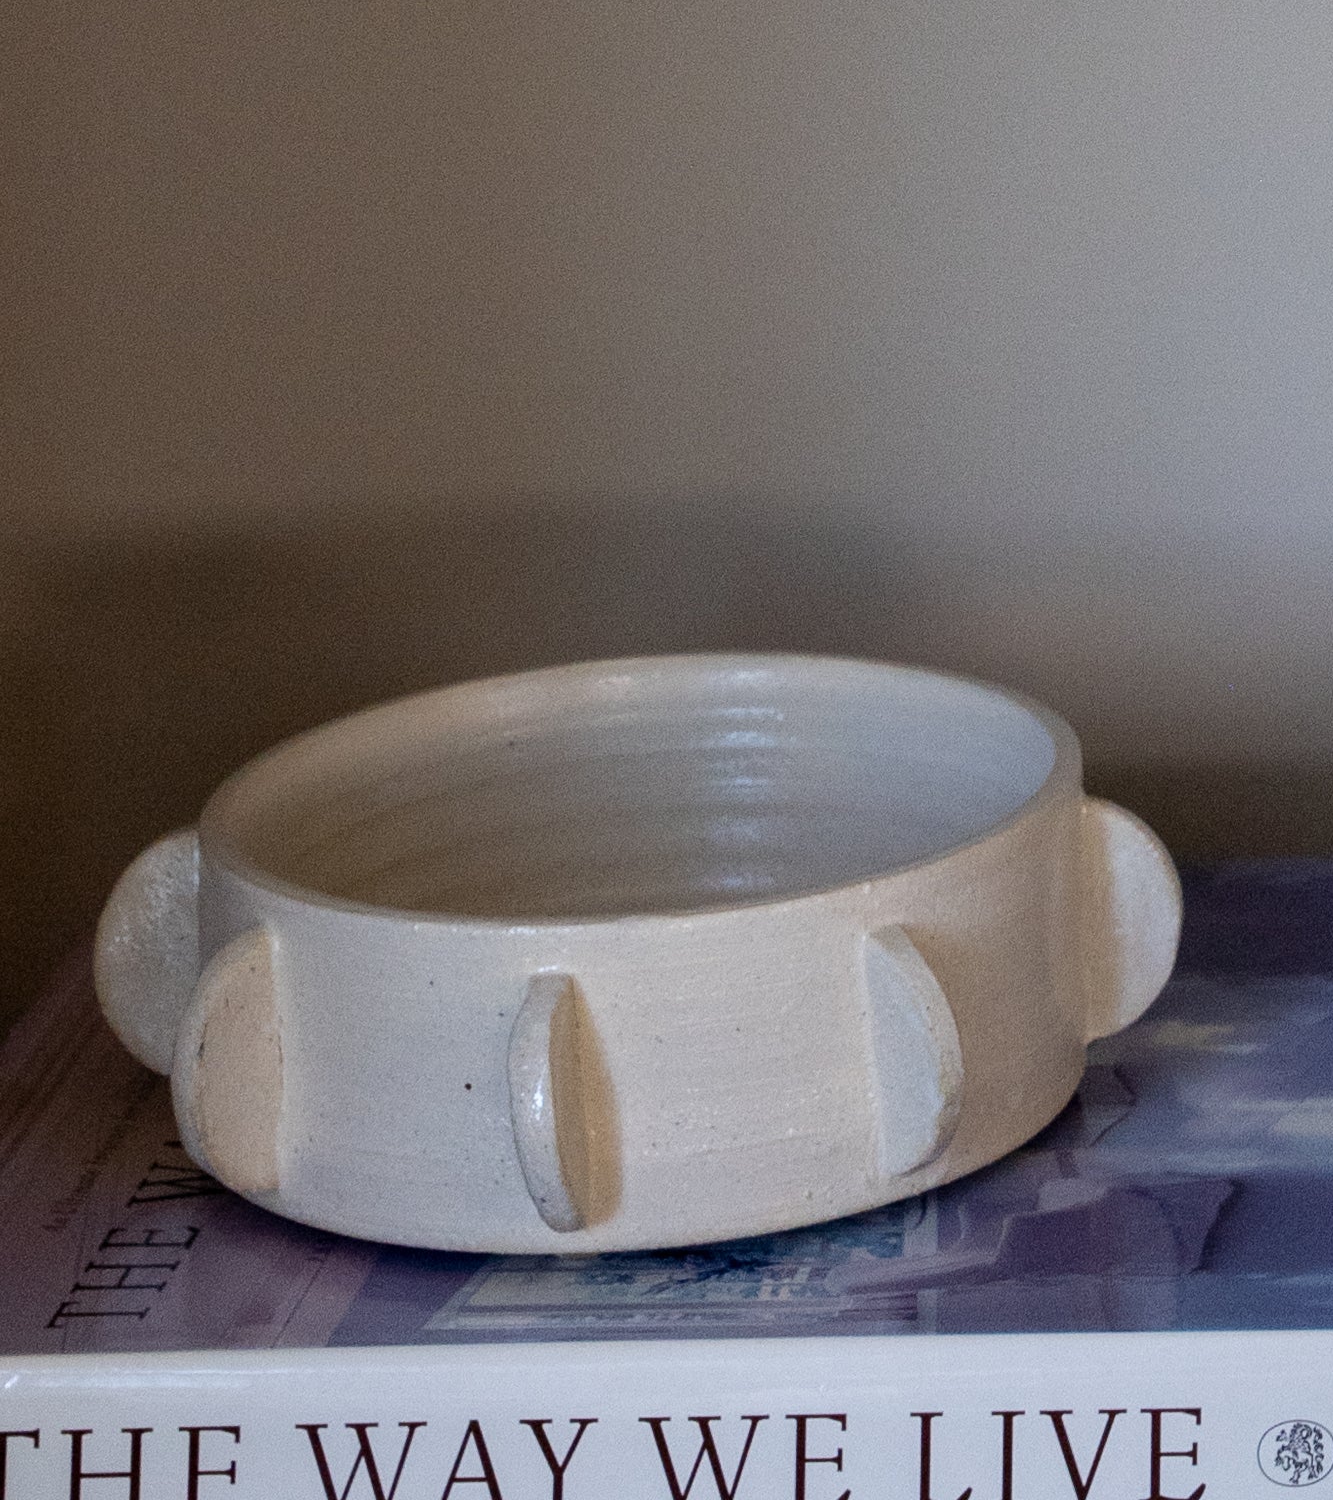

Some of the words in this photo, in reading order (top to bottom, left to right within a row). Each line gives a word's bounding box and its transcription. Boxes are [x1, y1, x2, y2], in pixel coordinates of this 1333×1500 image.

[46, 1225, 203, 1330] THE
[295, 1415, 600, 1500] WAY
[638, 1412, 853, 1500] WE
[910, 1407, 1207, 1500] LIVE
